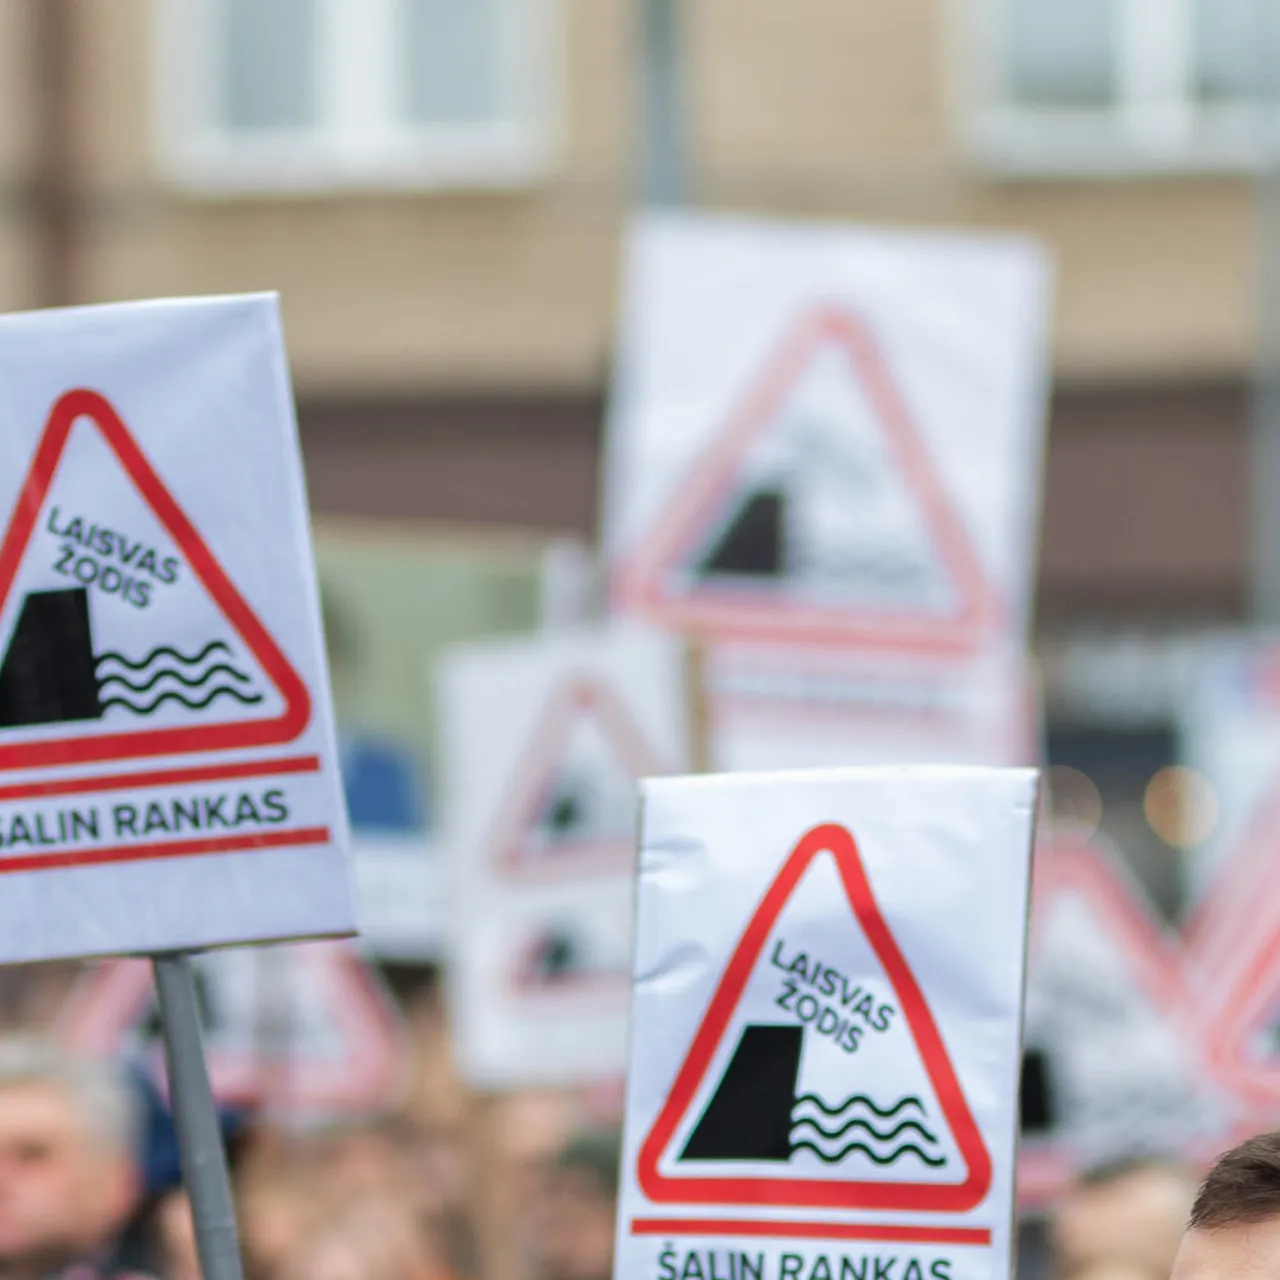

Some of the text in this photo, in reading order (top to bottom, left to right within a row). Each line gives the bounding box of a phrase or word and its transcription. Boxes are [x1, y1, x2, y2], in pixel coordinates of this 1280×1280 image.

[47, 504, 179, 584] LAISVAS
[53, 544, 152, 608] ŽODIS
[113, 789, 289, 837] RANKAS
[771, 940, 896, 1032] LAISVAS
[776, 978, 864, 1053] ŽODIS
